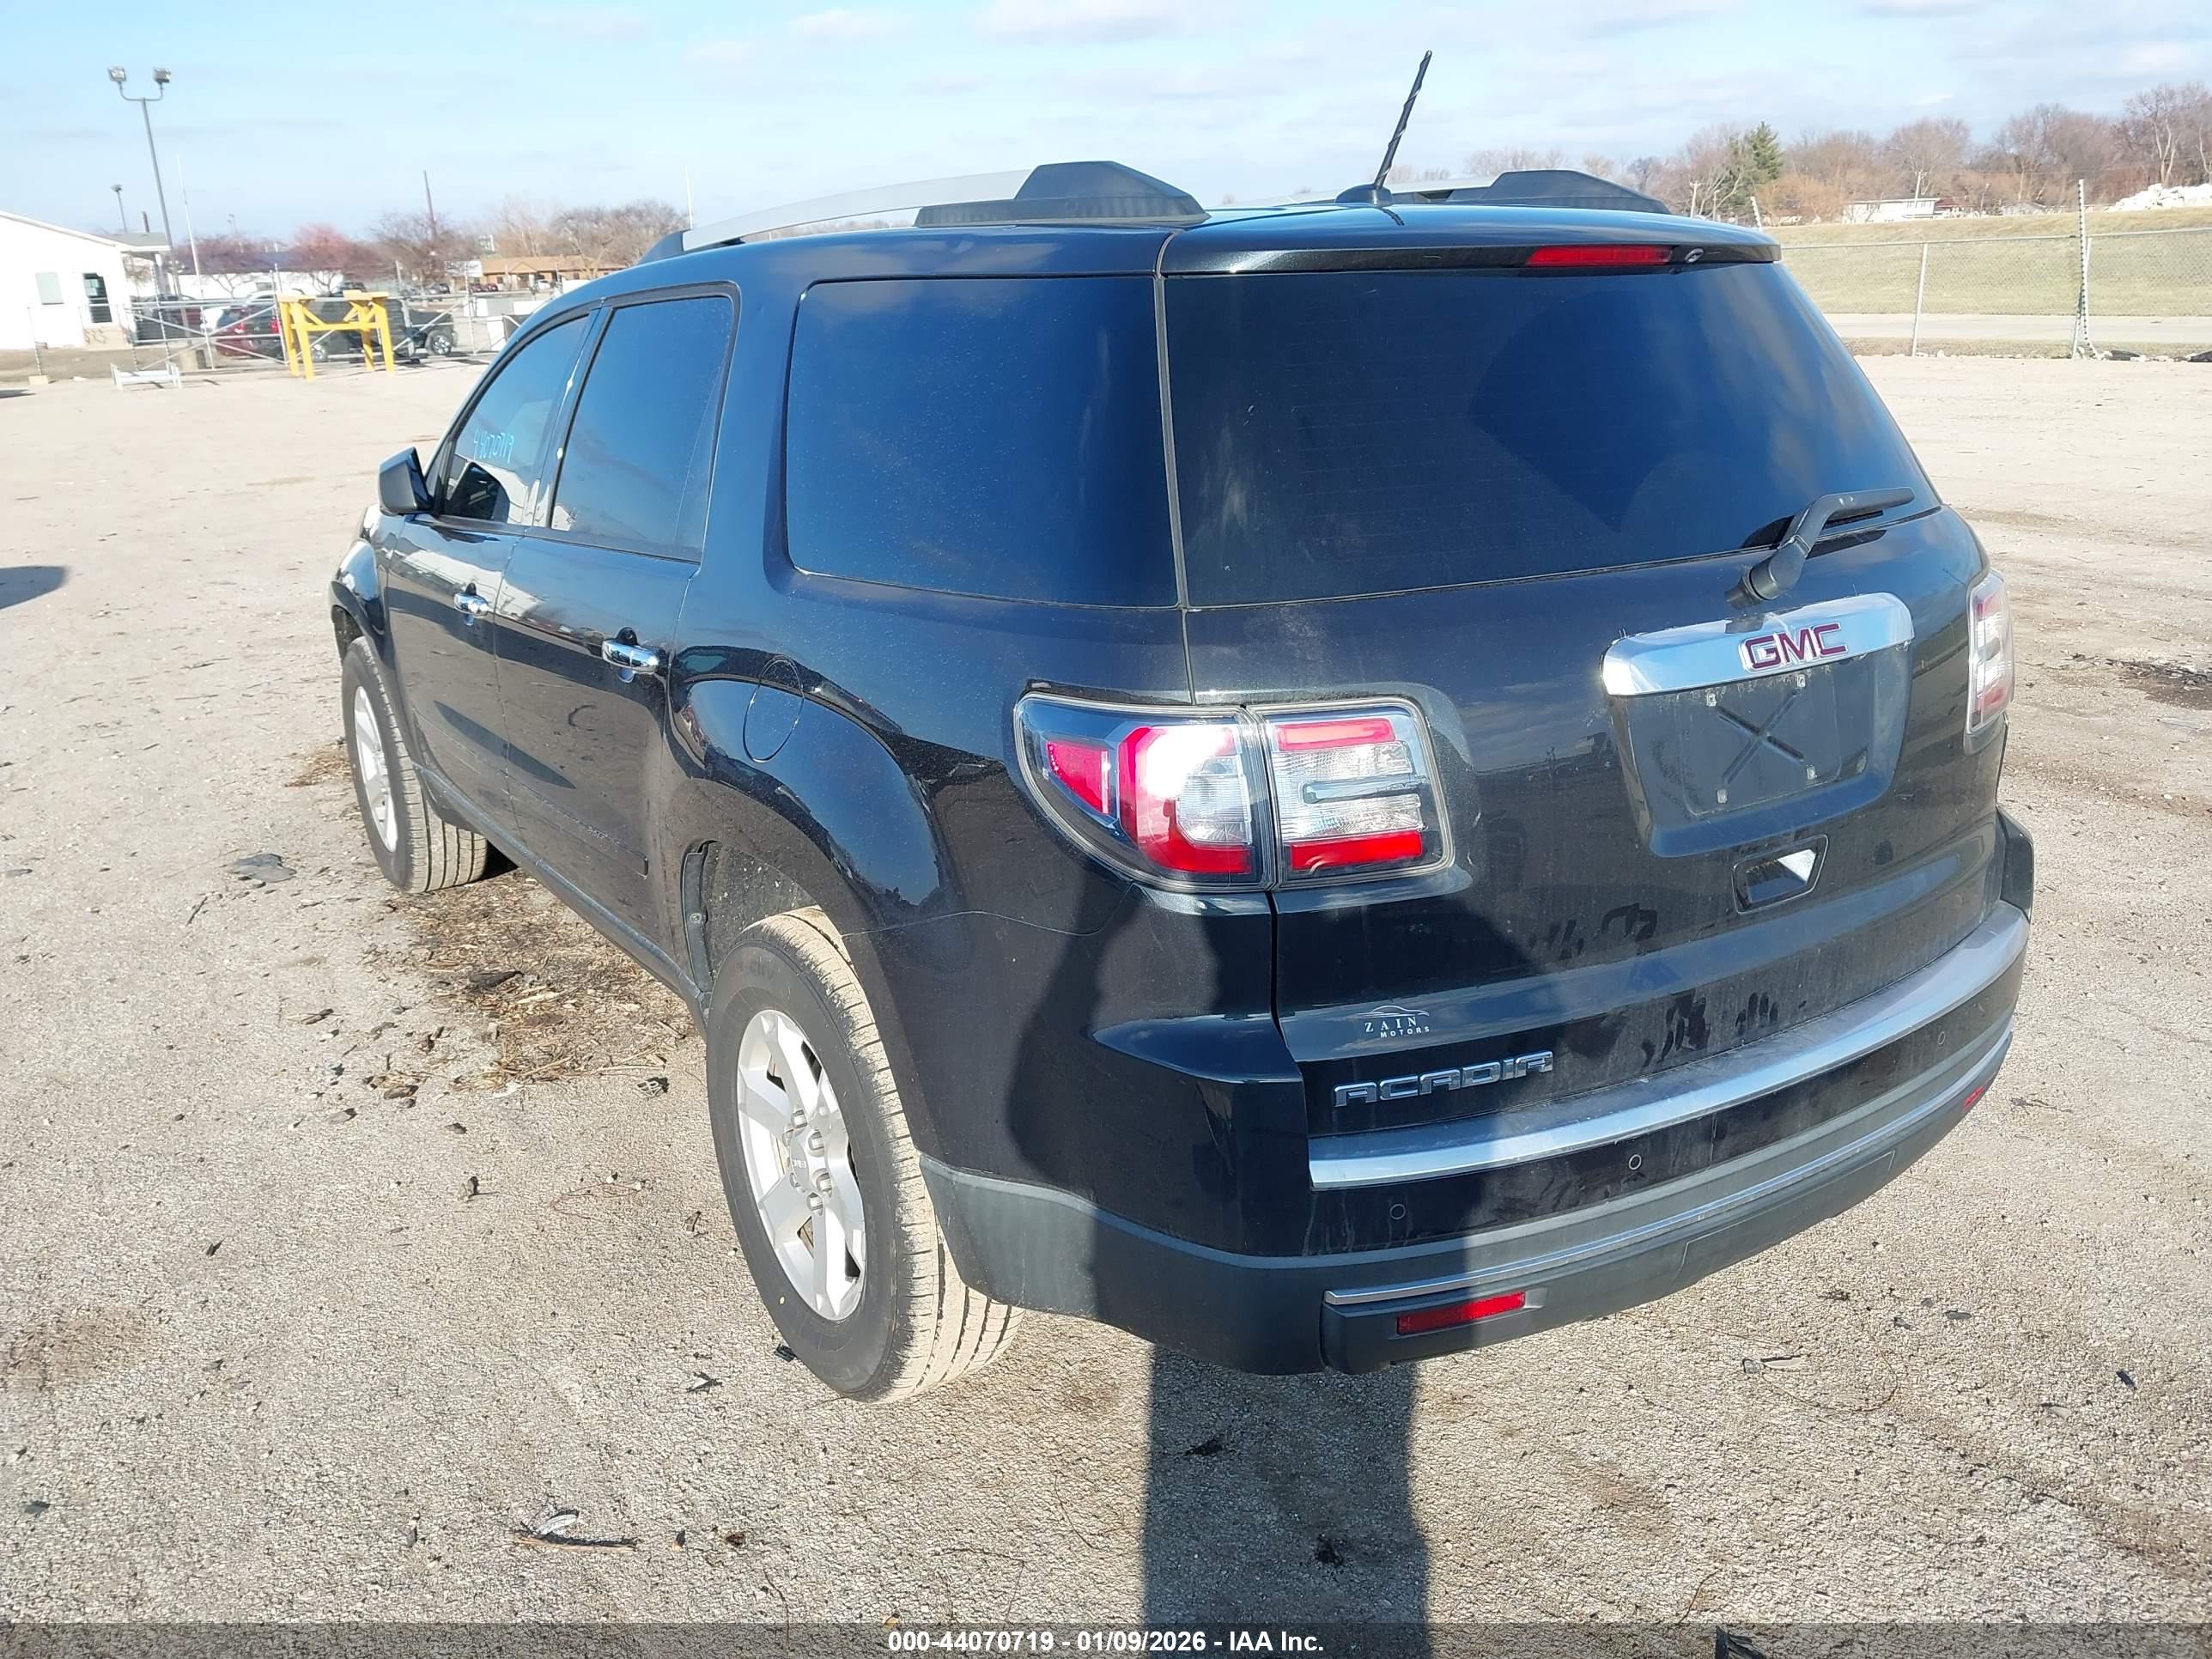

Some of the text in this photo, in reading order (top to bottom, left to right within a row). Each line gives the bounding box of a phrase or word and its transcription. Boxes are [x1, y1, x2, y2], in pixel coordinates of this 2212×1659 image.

[1741, 622, 1848, 672] GMC
[1364, 1017, 1418, 1032] ZAIN
[1379, 1025, 1430, 1038] MOTORS
[1334, 1051, 1553, 1107] ACADIA
